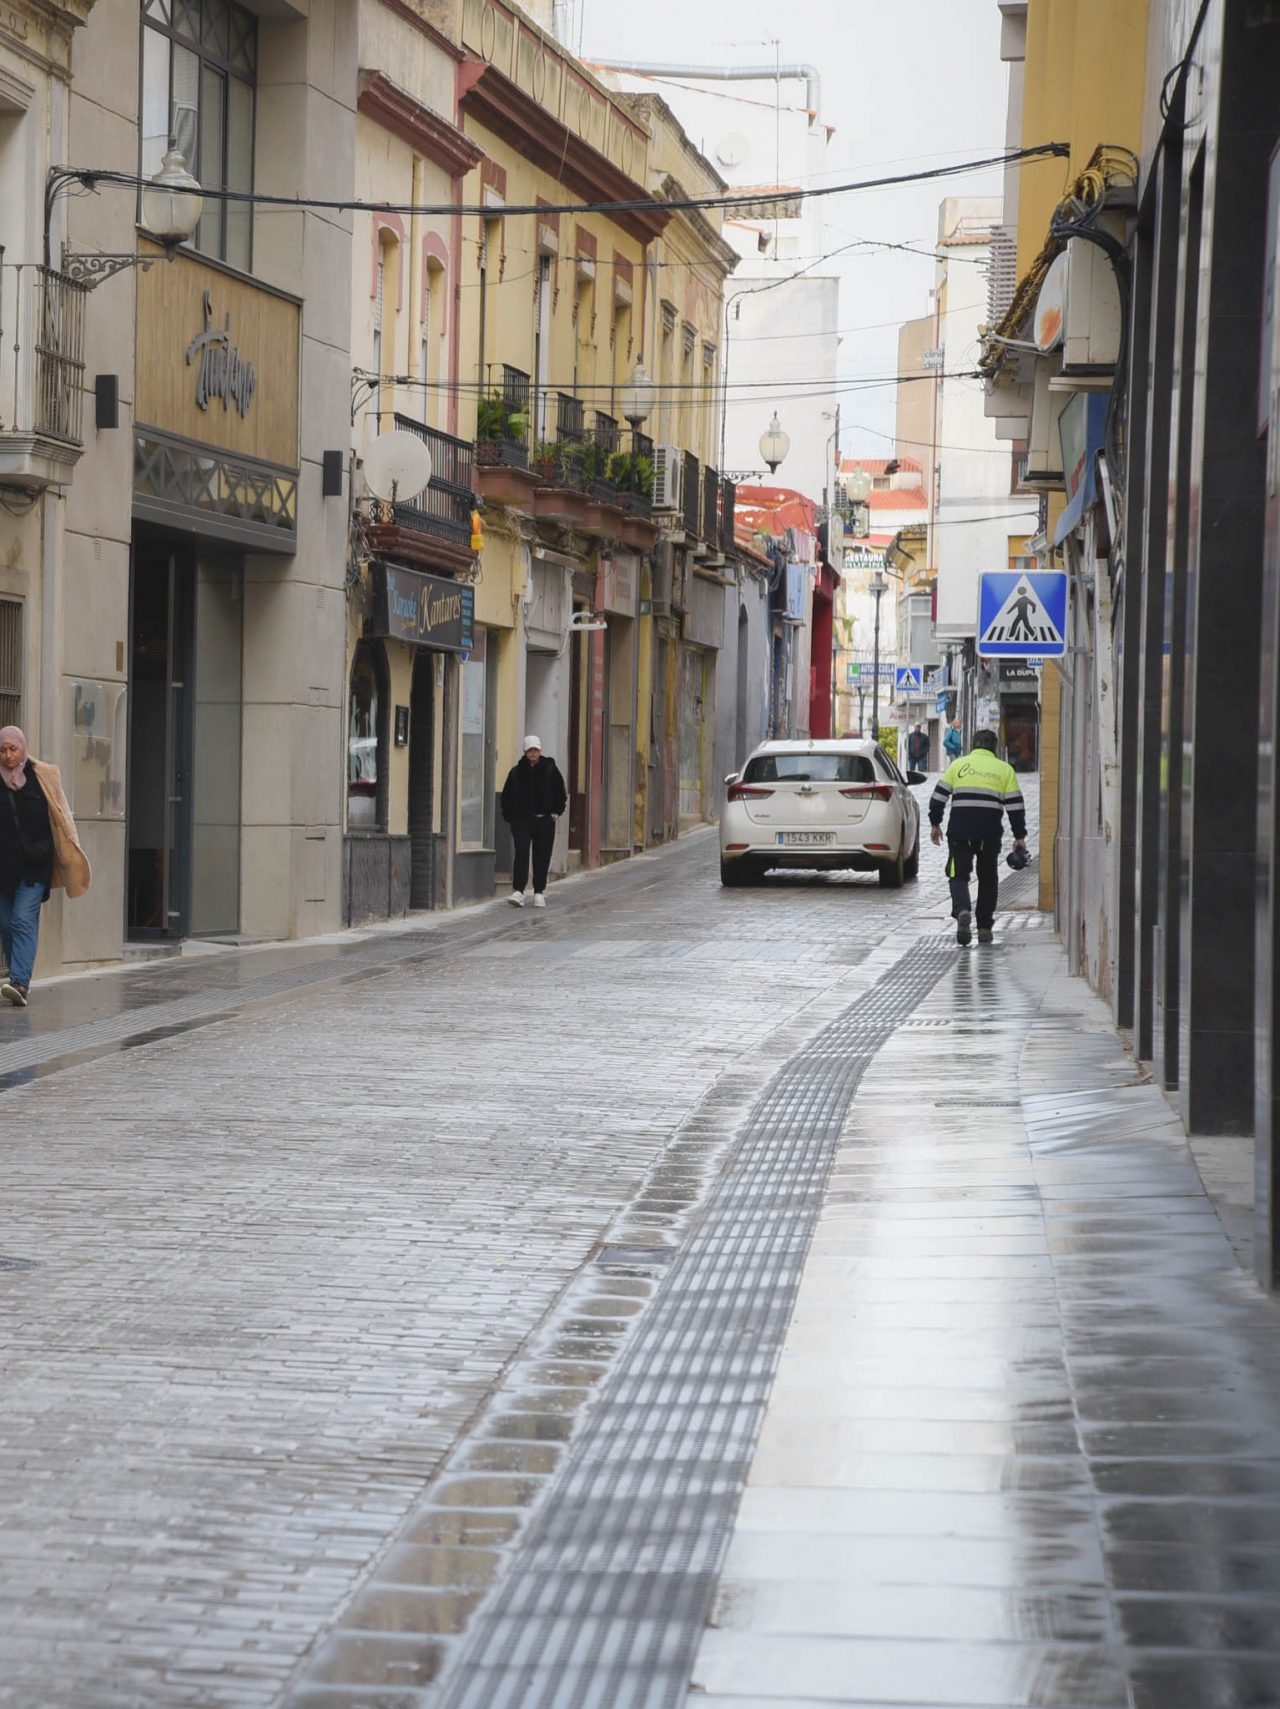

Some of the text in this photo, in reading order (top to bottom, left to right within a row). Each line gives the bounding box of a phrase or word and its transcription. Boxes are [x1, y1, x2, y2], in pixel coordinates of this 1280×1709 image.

[420, 583, 461, 635] Kantares
[1006, 669, 1016, 677] LA
[786, 833, 832, 843] 1543 KKR
